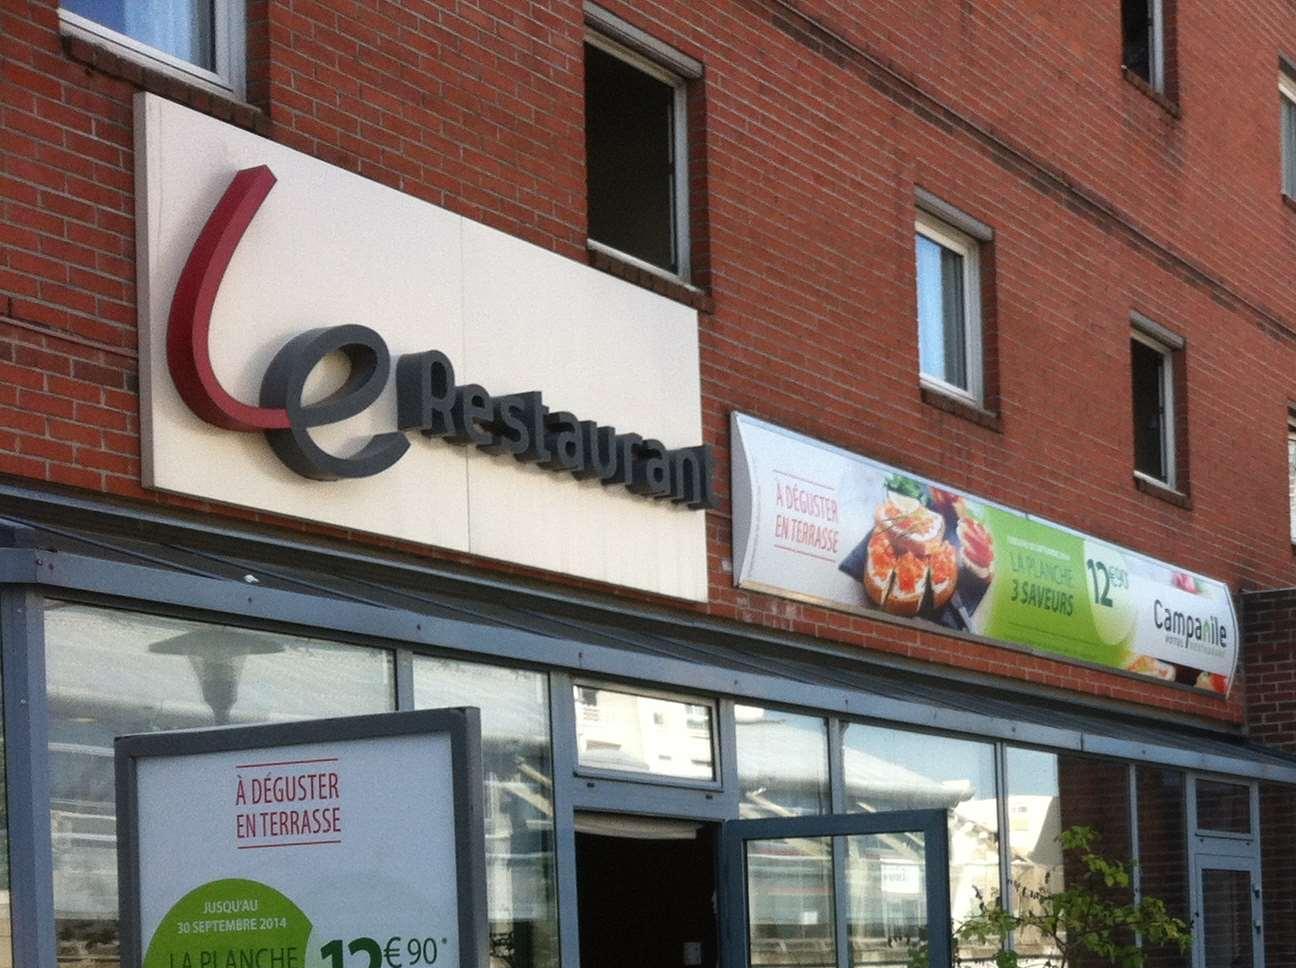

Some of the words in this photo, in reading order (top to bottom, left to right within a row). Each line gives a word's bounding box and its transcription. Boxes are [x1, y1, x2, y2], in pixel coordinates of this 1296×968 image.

[166, 164, 412, 482] Le
[396, 350, 716, 510] Restaurant
[775, 514, 790, 540] EN
[790, 518, 840, 554] TERRASSE
[1011, 579, 1019, 602] 3
[1022, 581, 1074, 617] SAVEURS
[1154, 599, 1227, 648] Campanile
[236, 775, 246, 806] À
[252, 771, 339, 805] DÉGUSTER
[236, 813, 256, 839] EN
[260, 807, 341, 837] TERRASSE
[177, 922, 190, 935] 30
[192, 918, 257, 934] SEPTEMBRE
[259, 917, 288, 930] 2014
[203, 900, 259, 915] JUSQU'AU
